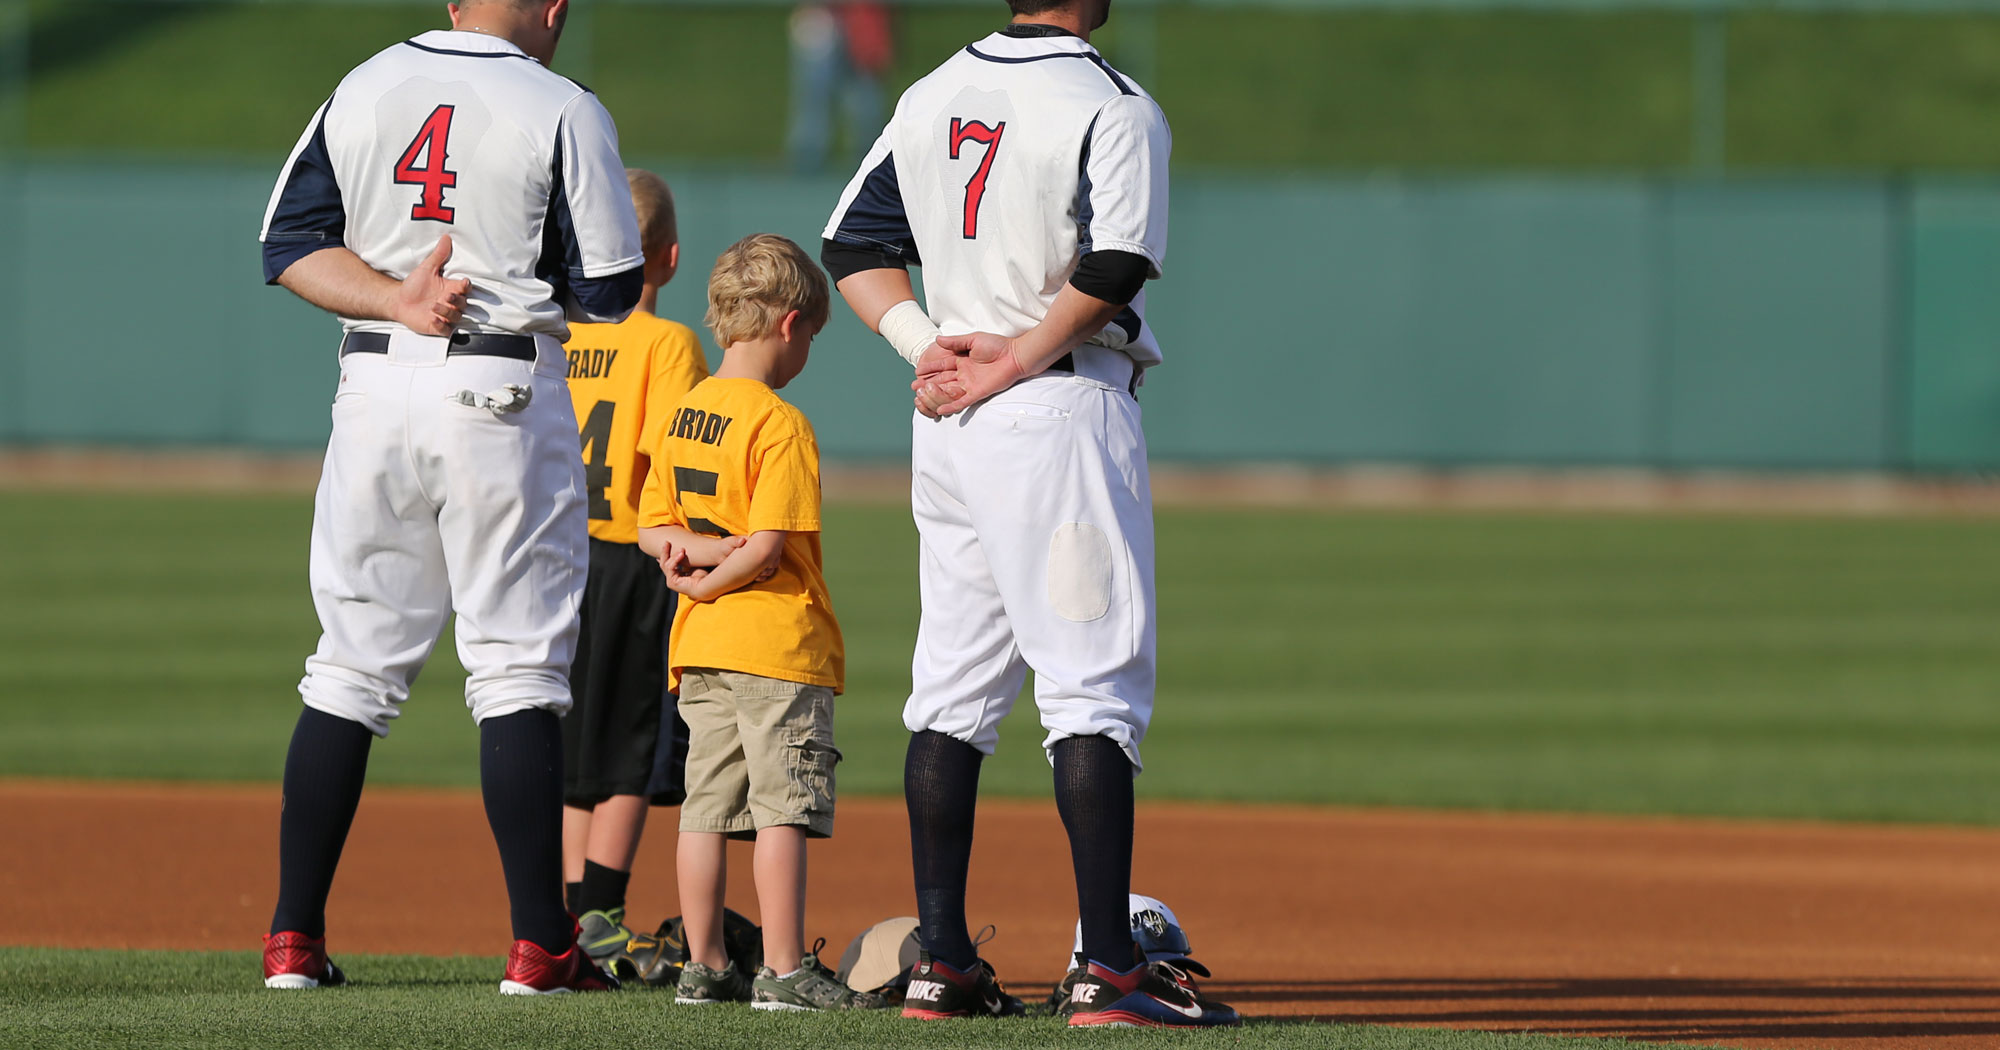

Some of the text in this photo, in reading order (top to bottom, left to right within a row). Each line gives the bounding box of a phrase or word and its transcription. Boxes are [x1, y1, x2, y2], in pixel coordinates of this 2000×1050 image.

[393, 104, 457, 225] 4
[949, 117, 1006, 240] 7
[566, 349, 618, 378] RADY
[581, 400, 616, 520] 4
[668, 407, 733, 447] BRODY
[673, 466, 732, 538] 5
[906, 979, 946, 1002] NIKE
